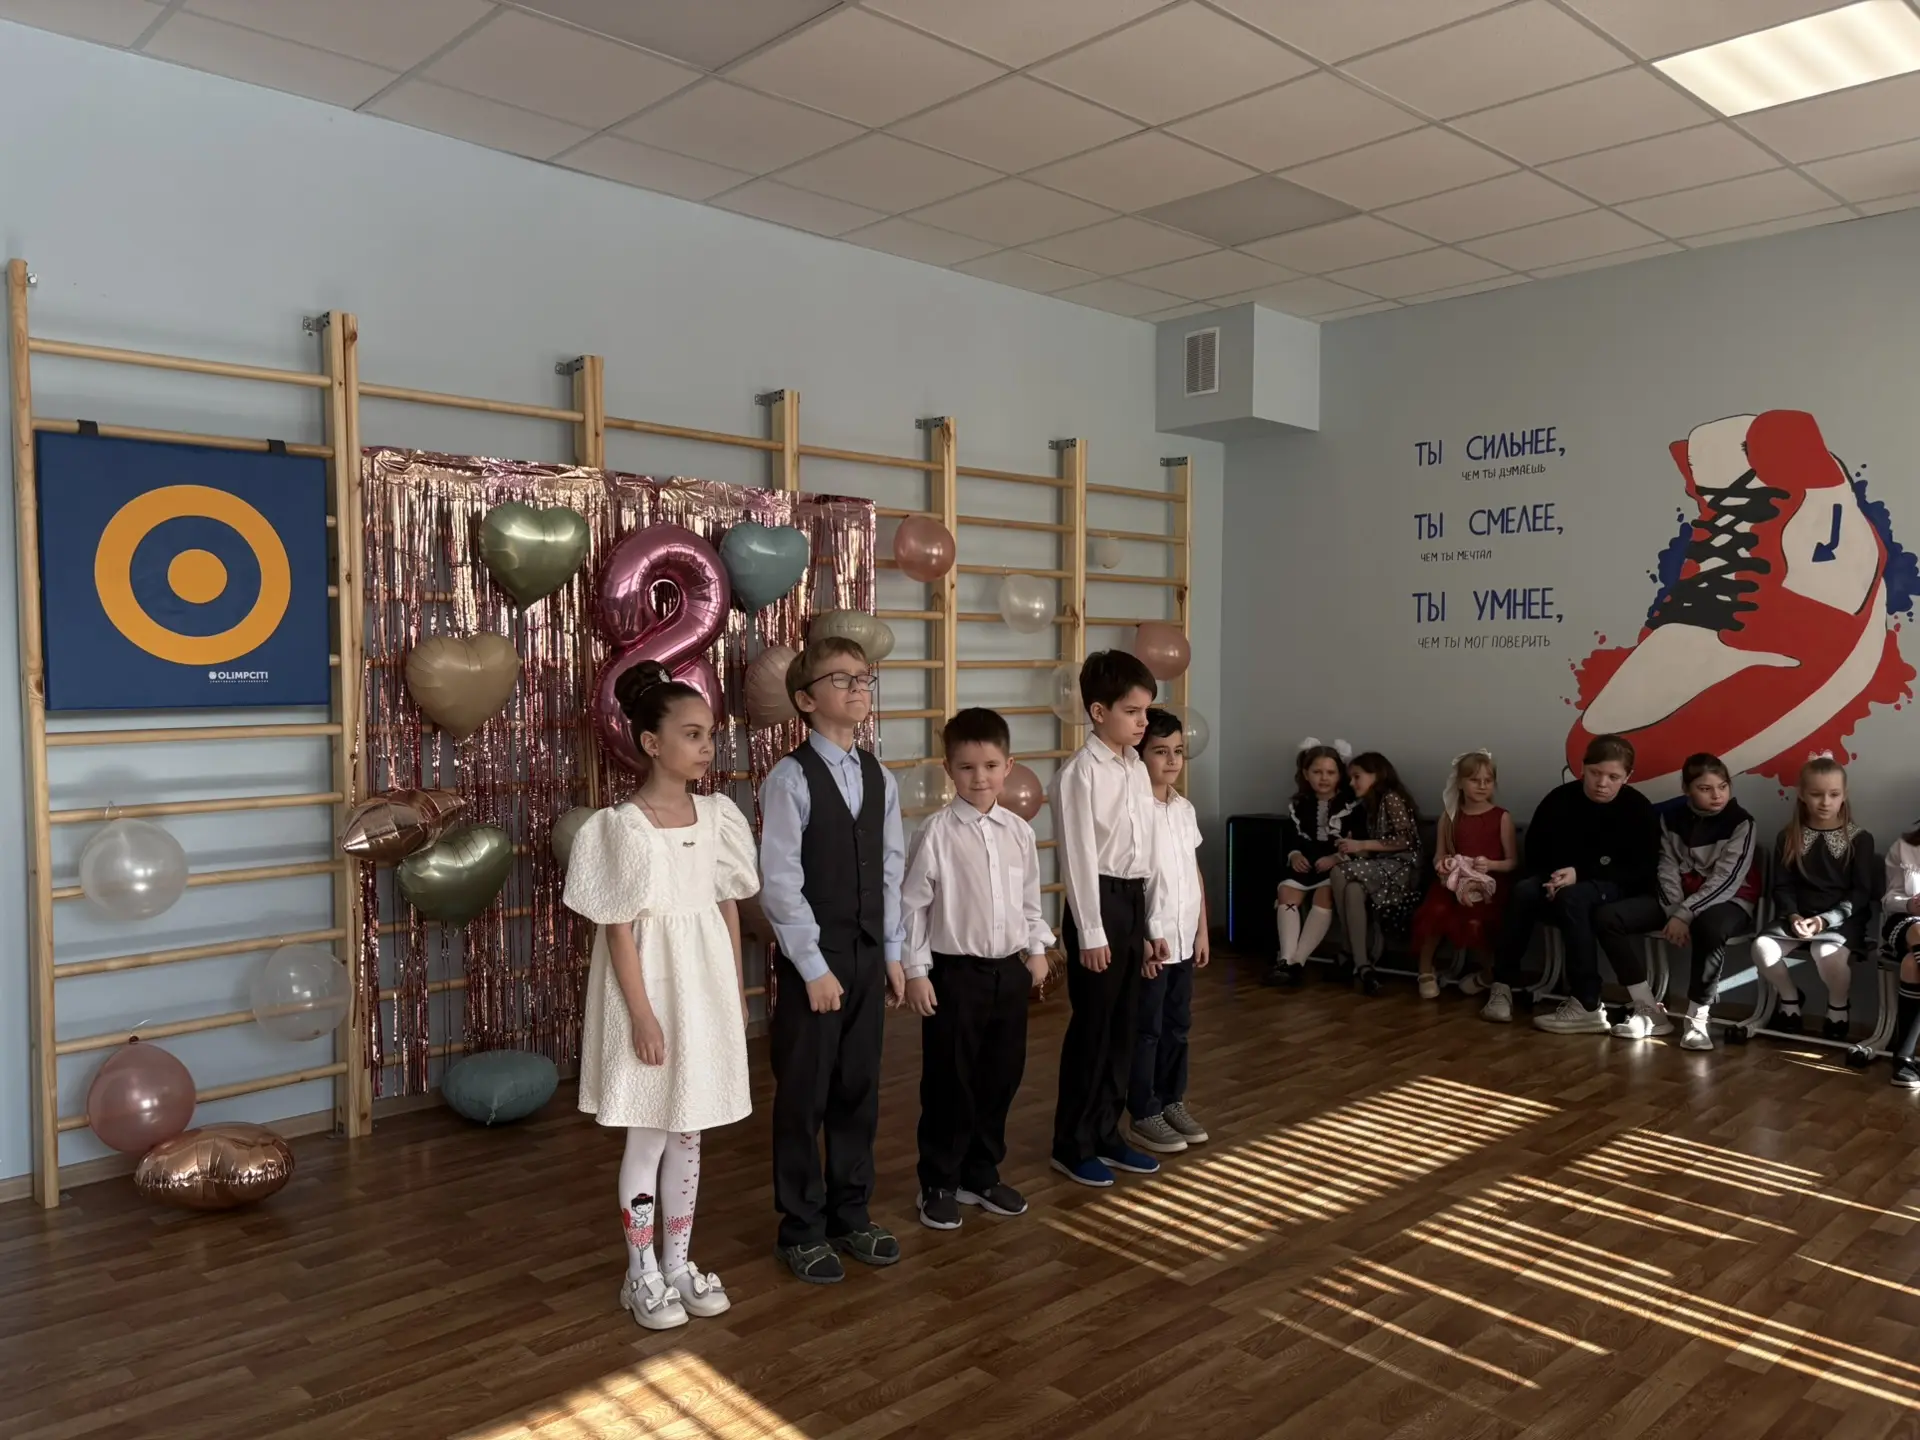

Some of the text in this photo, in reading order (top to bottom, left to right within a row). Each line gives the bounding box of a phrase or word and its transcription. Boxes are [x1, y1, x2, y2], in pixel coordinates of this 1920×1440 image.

[1414, 426, 1566, 467] ТЫ СИЛЬНЕЕ,
[1461, 463, 1547, 481] ЧЕМ ТЫ ДУМАЕШЬ
[1414, 503, 1564, 540] ТЫ СМЕЛЕЕ,
[1420, 549, 1492, 562] ЧЕМ ТЫ МЕЧТАЛ
[1412, 587, 1564, 623] ТЫ УМНЕЕ,
[1418, 634, 1551, 649] ЧЕМ ТЫ МОГ ПОВЕРИТЬ
[218, 671, 269, 680] OLIMPCITI
